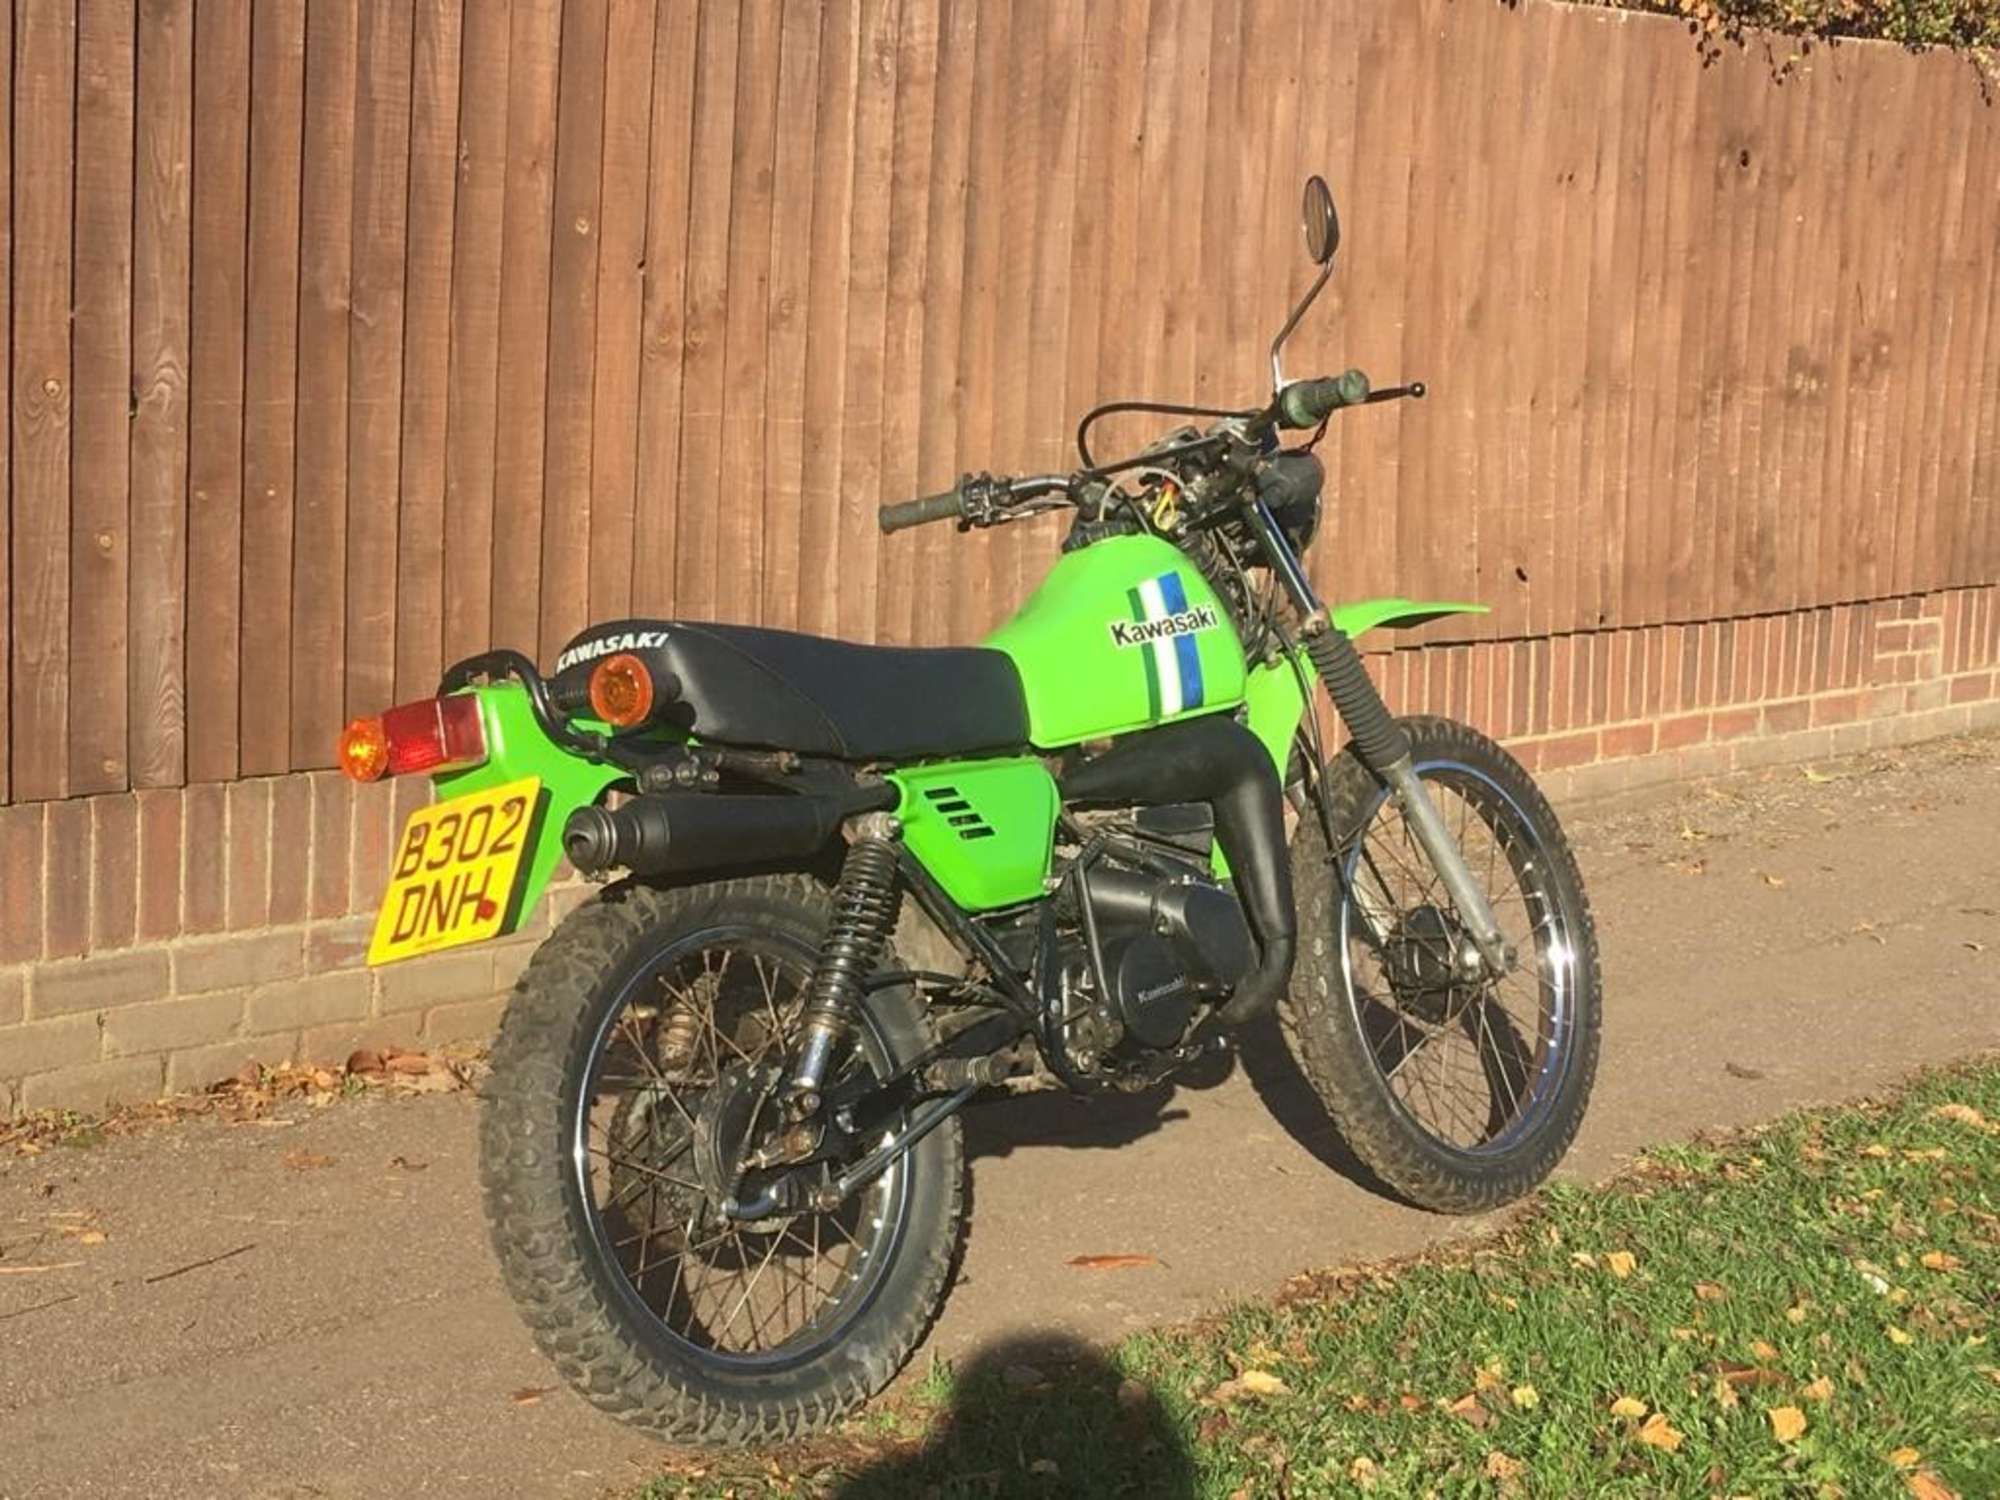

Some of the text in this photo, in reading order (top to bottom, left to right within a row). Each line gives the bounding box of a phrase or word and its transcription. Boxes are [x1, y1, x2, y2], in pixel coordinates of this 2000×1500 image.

[556, 632, 669, 675] KAWASAKI
[1110, 605, 1218, 646] Kawasaki
[395, 797, 527, 880] B302
[390, 866, 493, 944] DNH
